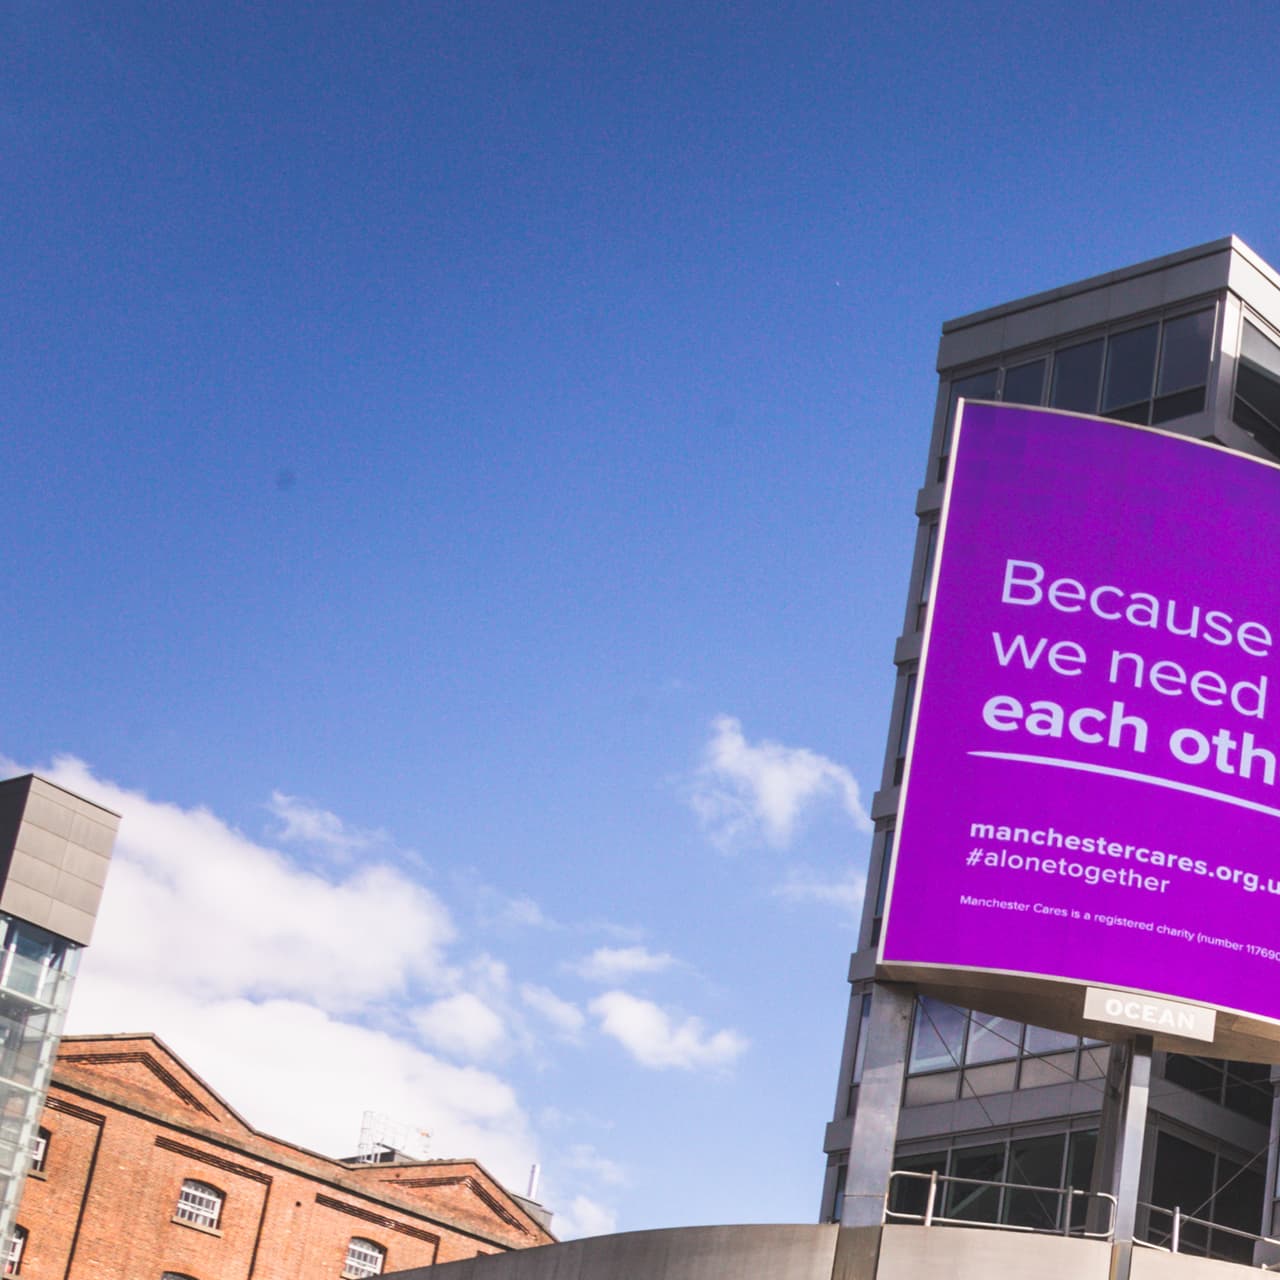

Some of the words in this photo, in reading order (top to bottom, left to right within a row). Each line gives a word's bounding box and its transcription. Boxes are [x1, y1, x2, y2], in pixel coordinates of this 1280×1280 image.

[1001, 559, 1273, 656] Because
[991, 631, 1087, 676] we
[1109, 648, 1269, 719] need
[982, 694, 1148, 752] each
[965, 847, 1171, 894] #alonetogether
[960, 895, 1030, 912] Manchester
[1033, 902, 1068, 918] Cares
[1071, 908, 1081, 920] is
[1083, 911, 1091, 922] a
[1094, 912, 1154, 932] registered
[1156, 922, 1195, 942] charity
[1196, 931, 1244, 952] (number
[1104, 998, 1195, 1031] OCEAN
